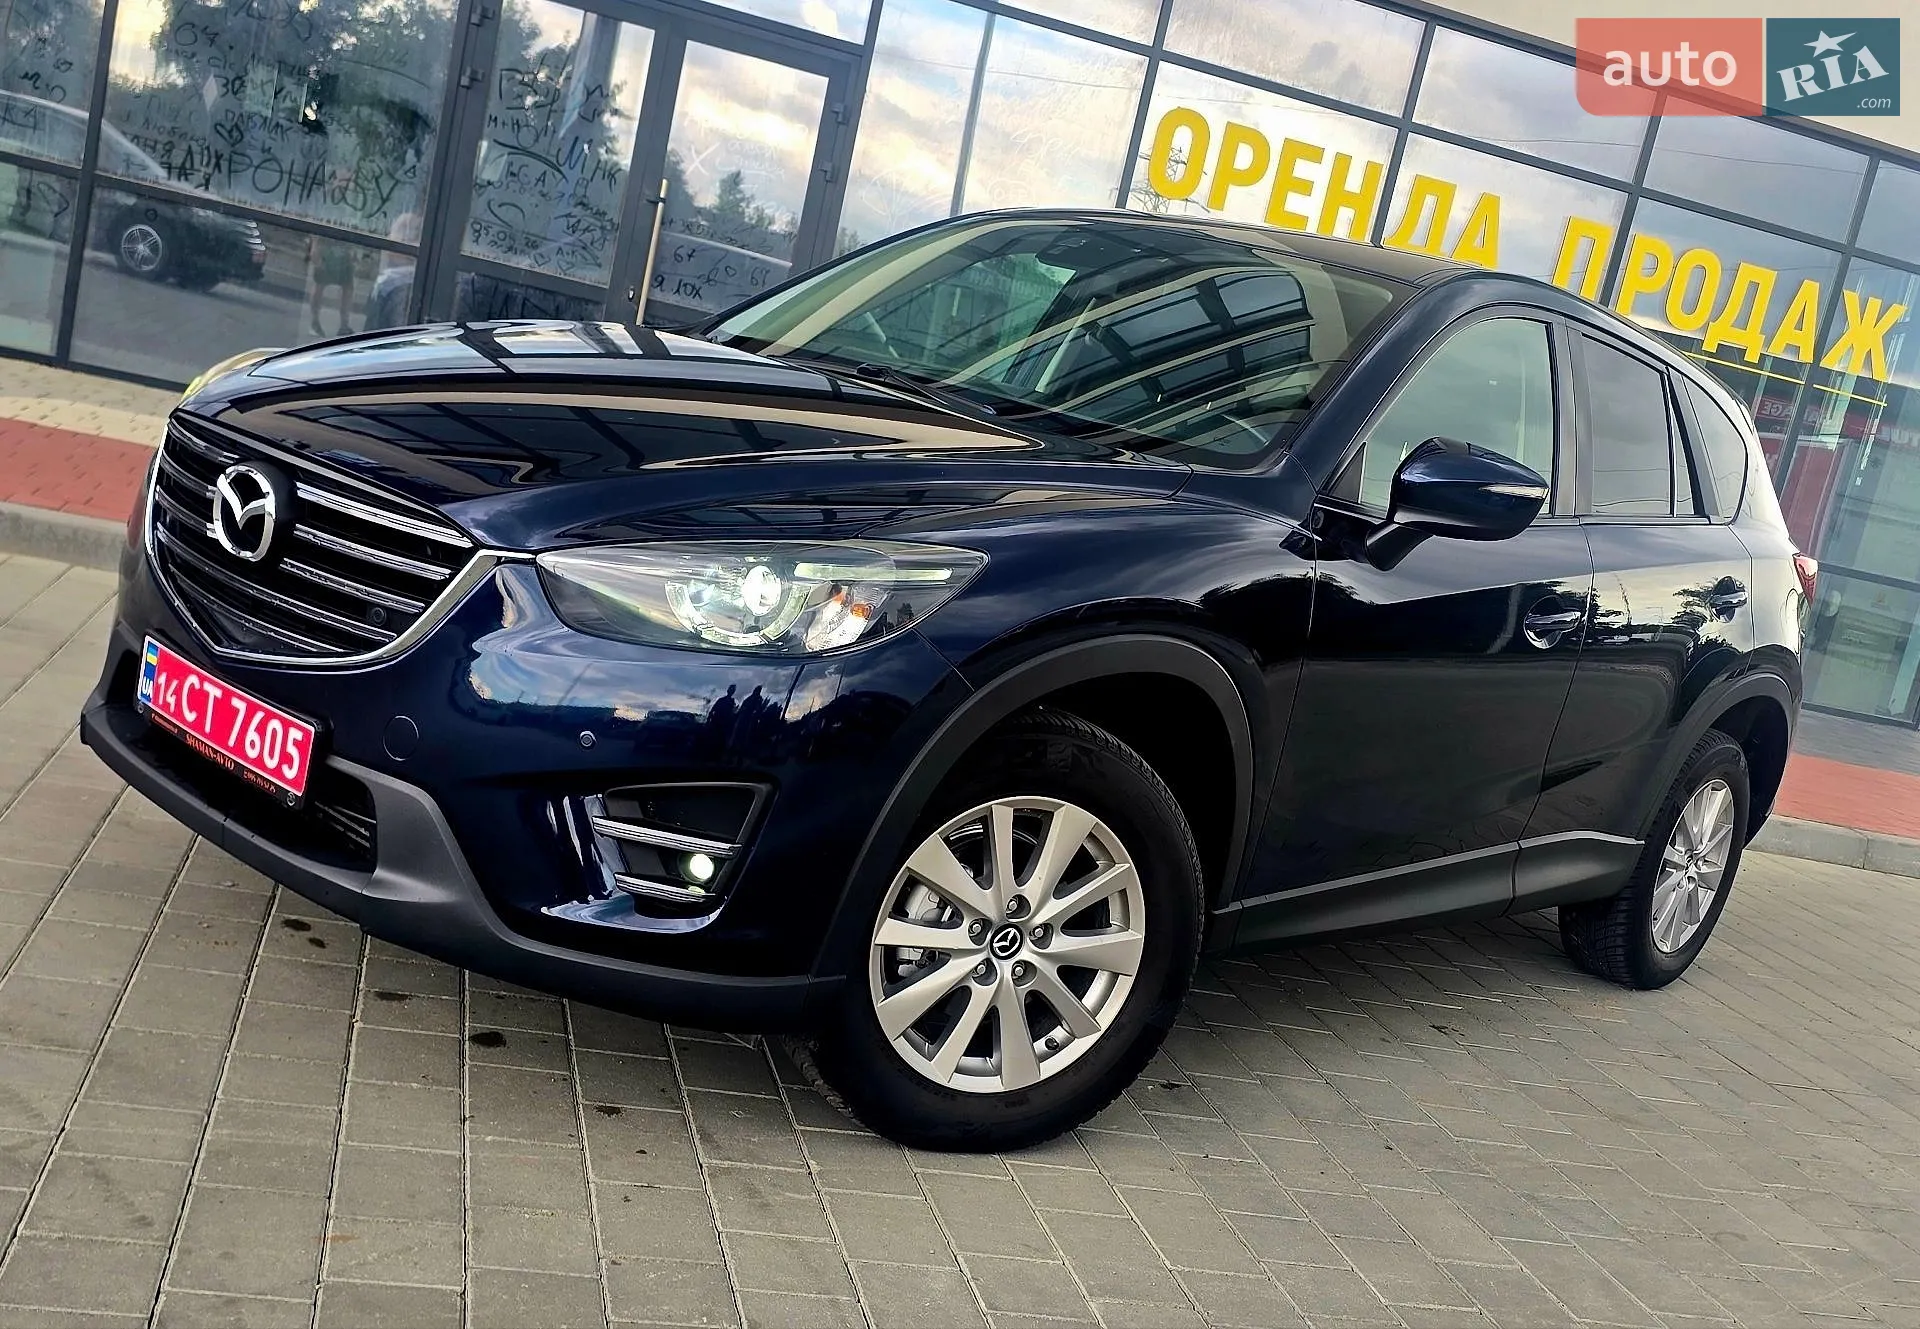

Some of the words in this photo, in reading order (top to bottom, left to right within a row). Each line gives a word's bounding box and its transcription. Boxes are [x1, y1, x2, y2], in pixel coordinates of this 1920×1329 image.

[1148, 106, 1501, 270] ОРЕНДА
[1552, 216, 1908, 383] ПРОДАЖ
[227, 697, 304, 780] 7605
